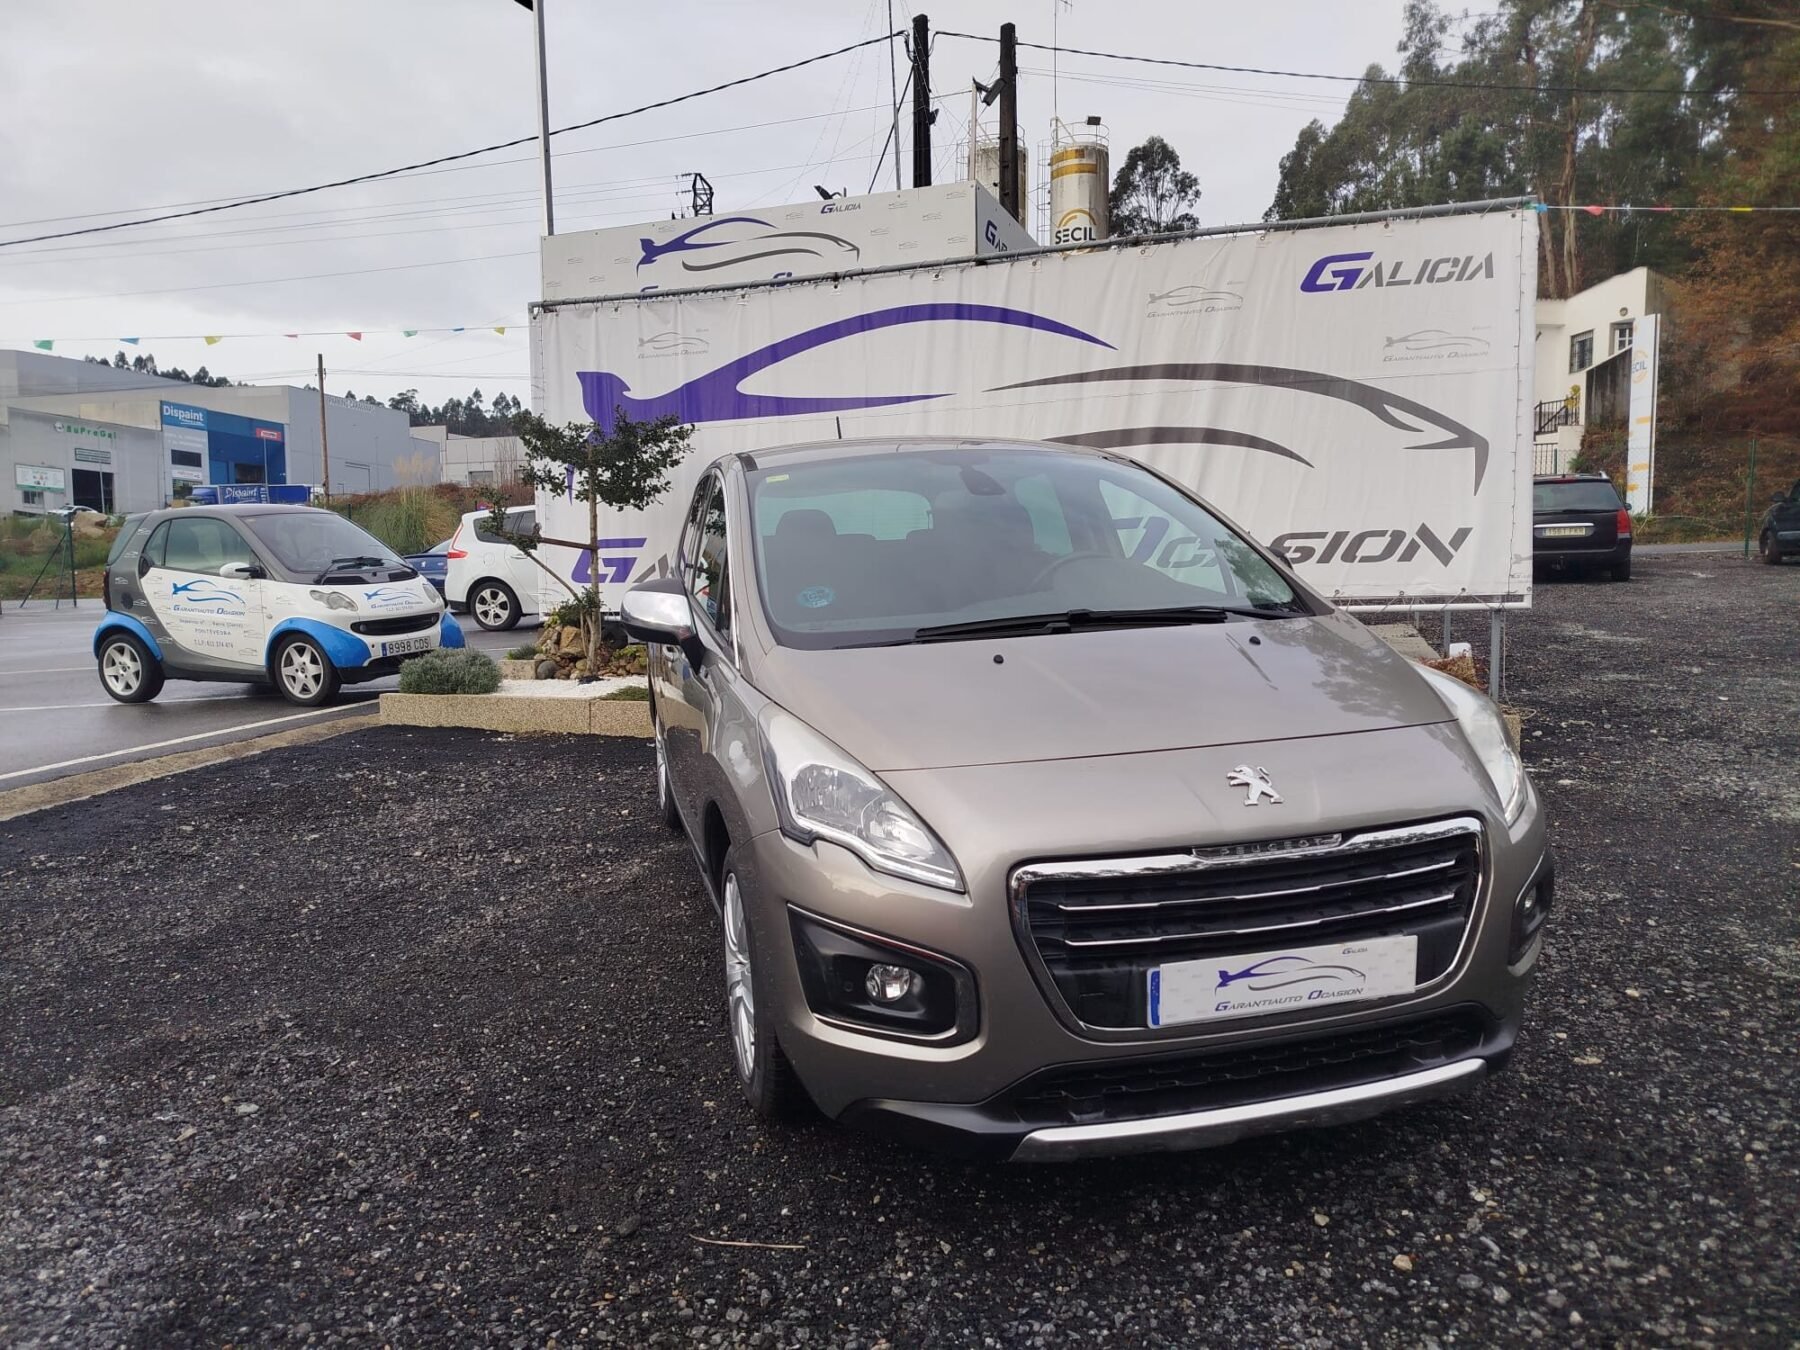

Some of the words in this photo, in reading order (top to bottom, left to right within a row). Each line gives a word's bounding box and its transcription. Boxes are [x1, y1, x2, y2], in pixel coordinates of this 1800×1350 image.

[1054, 226, 1097, 245] SECIL
[1300, 251, 1494, 293] GALICIA
[162, 404, 205, 423] Dispaint
[388, 642, 412, 655] 8998
[1219, 837, 1323, 855] PEUGEOT
[1214, 995, 1304, 1012] GARANTIAUTO
[1307, 987, 1365, 1001] OCASION
